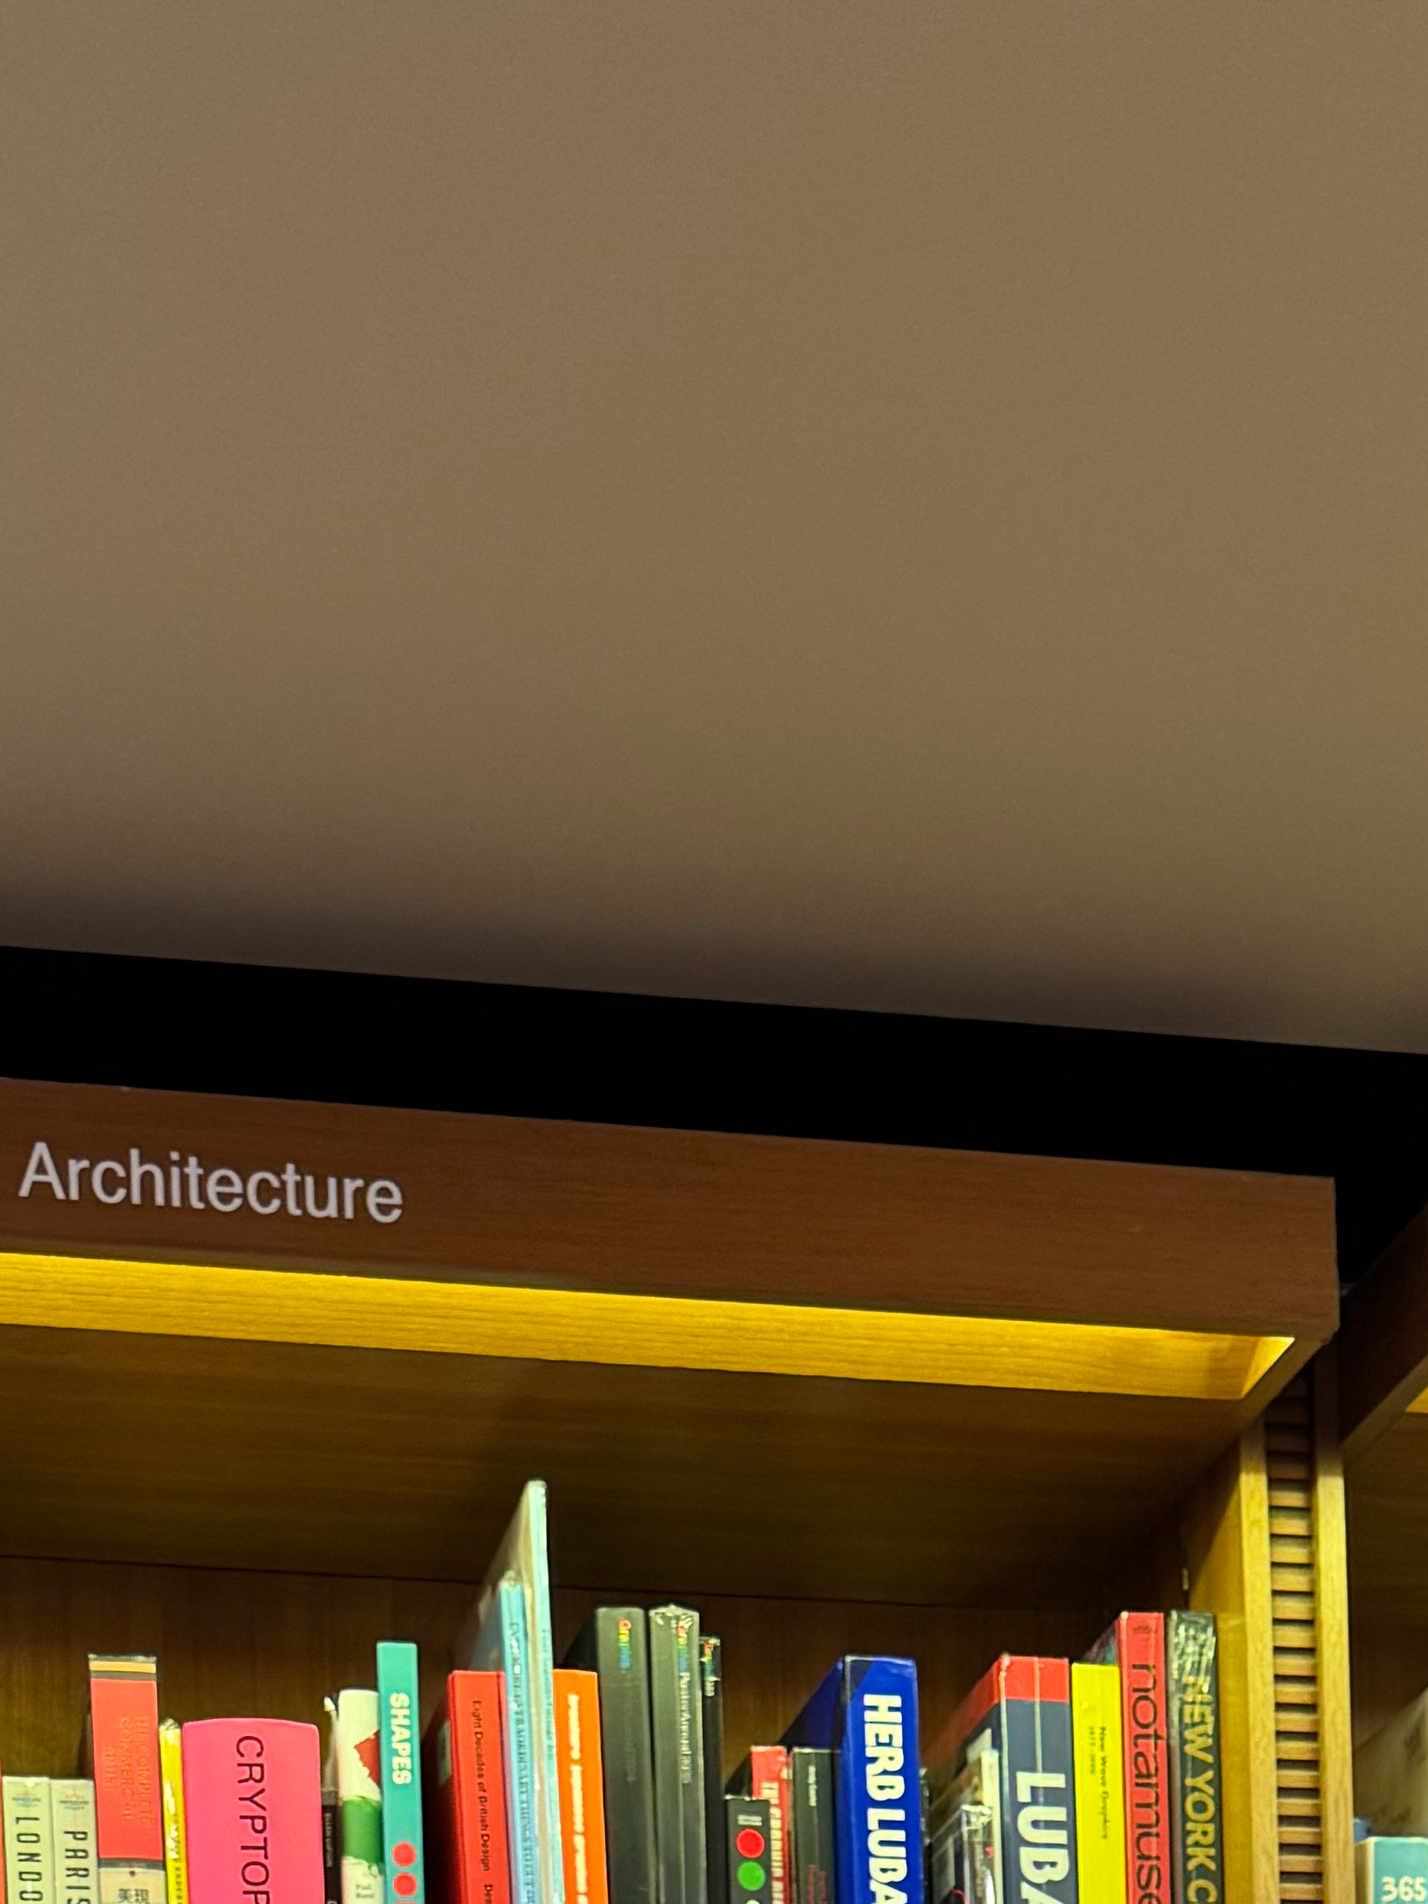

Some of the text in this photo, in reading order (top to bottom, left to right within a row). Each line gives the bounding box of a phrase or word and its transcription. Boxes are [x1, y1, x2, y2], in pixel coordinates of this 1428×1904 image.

[17, 1141, 404, 1224] Architecture
[389, 1692, 412, 1787] SHAPES
[863, 1693, 905, 1800] HERB
[1381, 1877, 1426, 1901] 365
